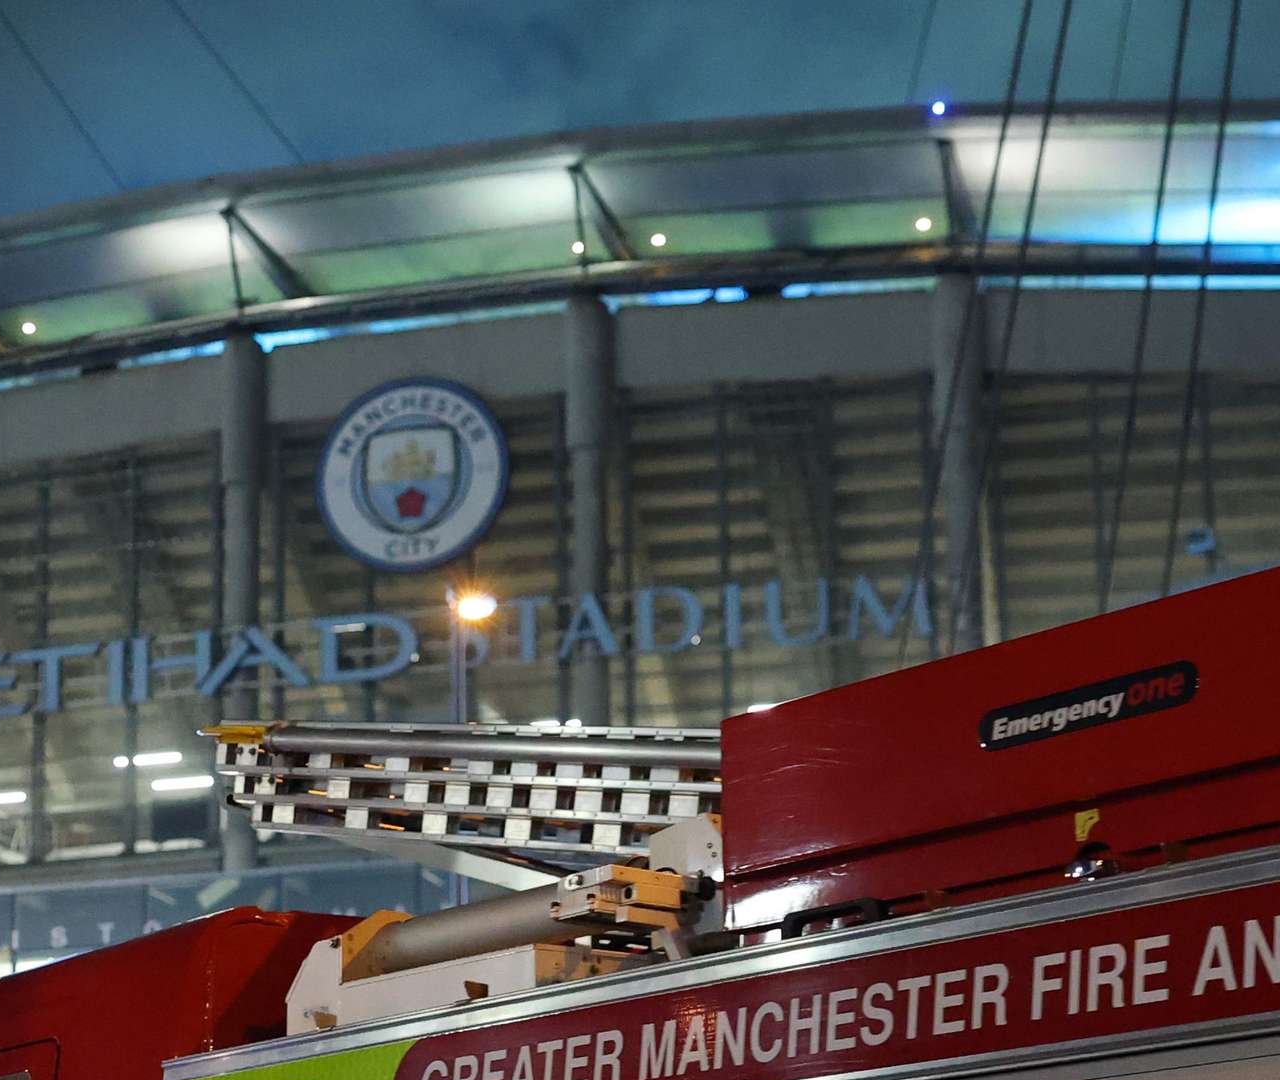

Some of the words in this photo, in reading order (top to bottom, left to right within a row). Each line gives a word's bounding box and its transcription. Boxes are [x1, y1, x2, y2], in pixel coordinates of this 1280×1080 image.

[338, 392, 488, 456] MANCHESTER
[383, 536, 440, 558] CITY
[448, 574, 934, 669] TADIUM
[990, 691, 1126, 741] Emergency
[1127, 670, 1188, 707] one
[1030, 934, 1170, 1021] FIRE
